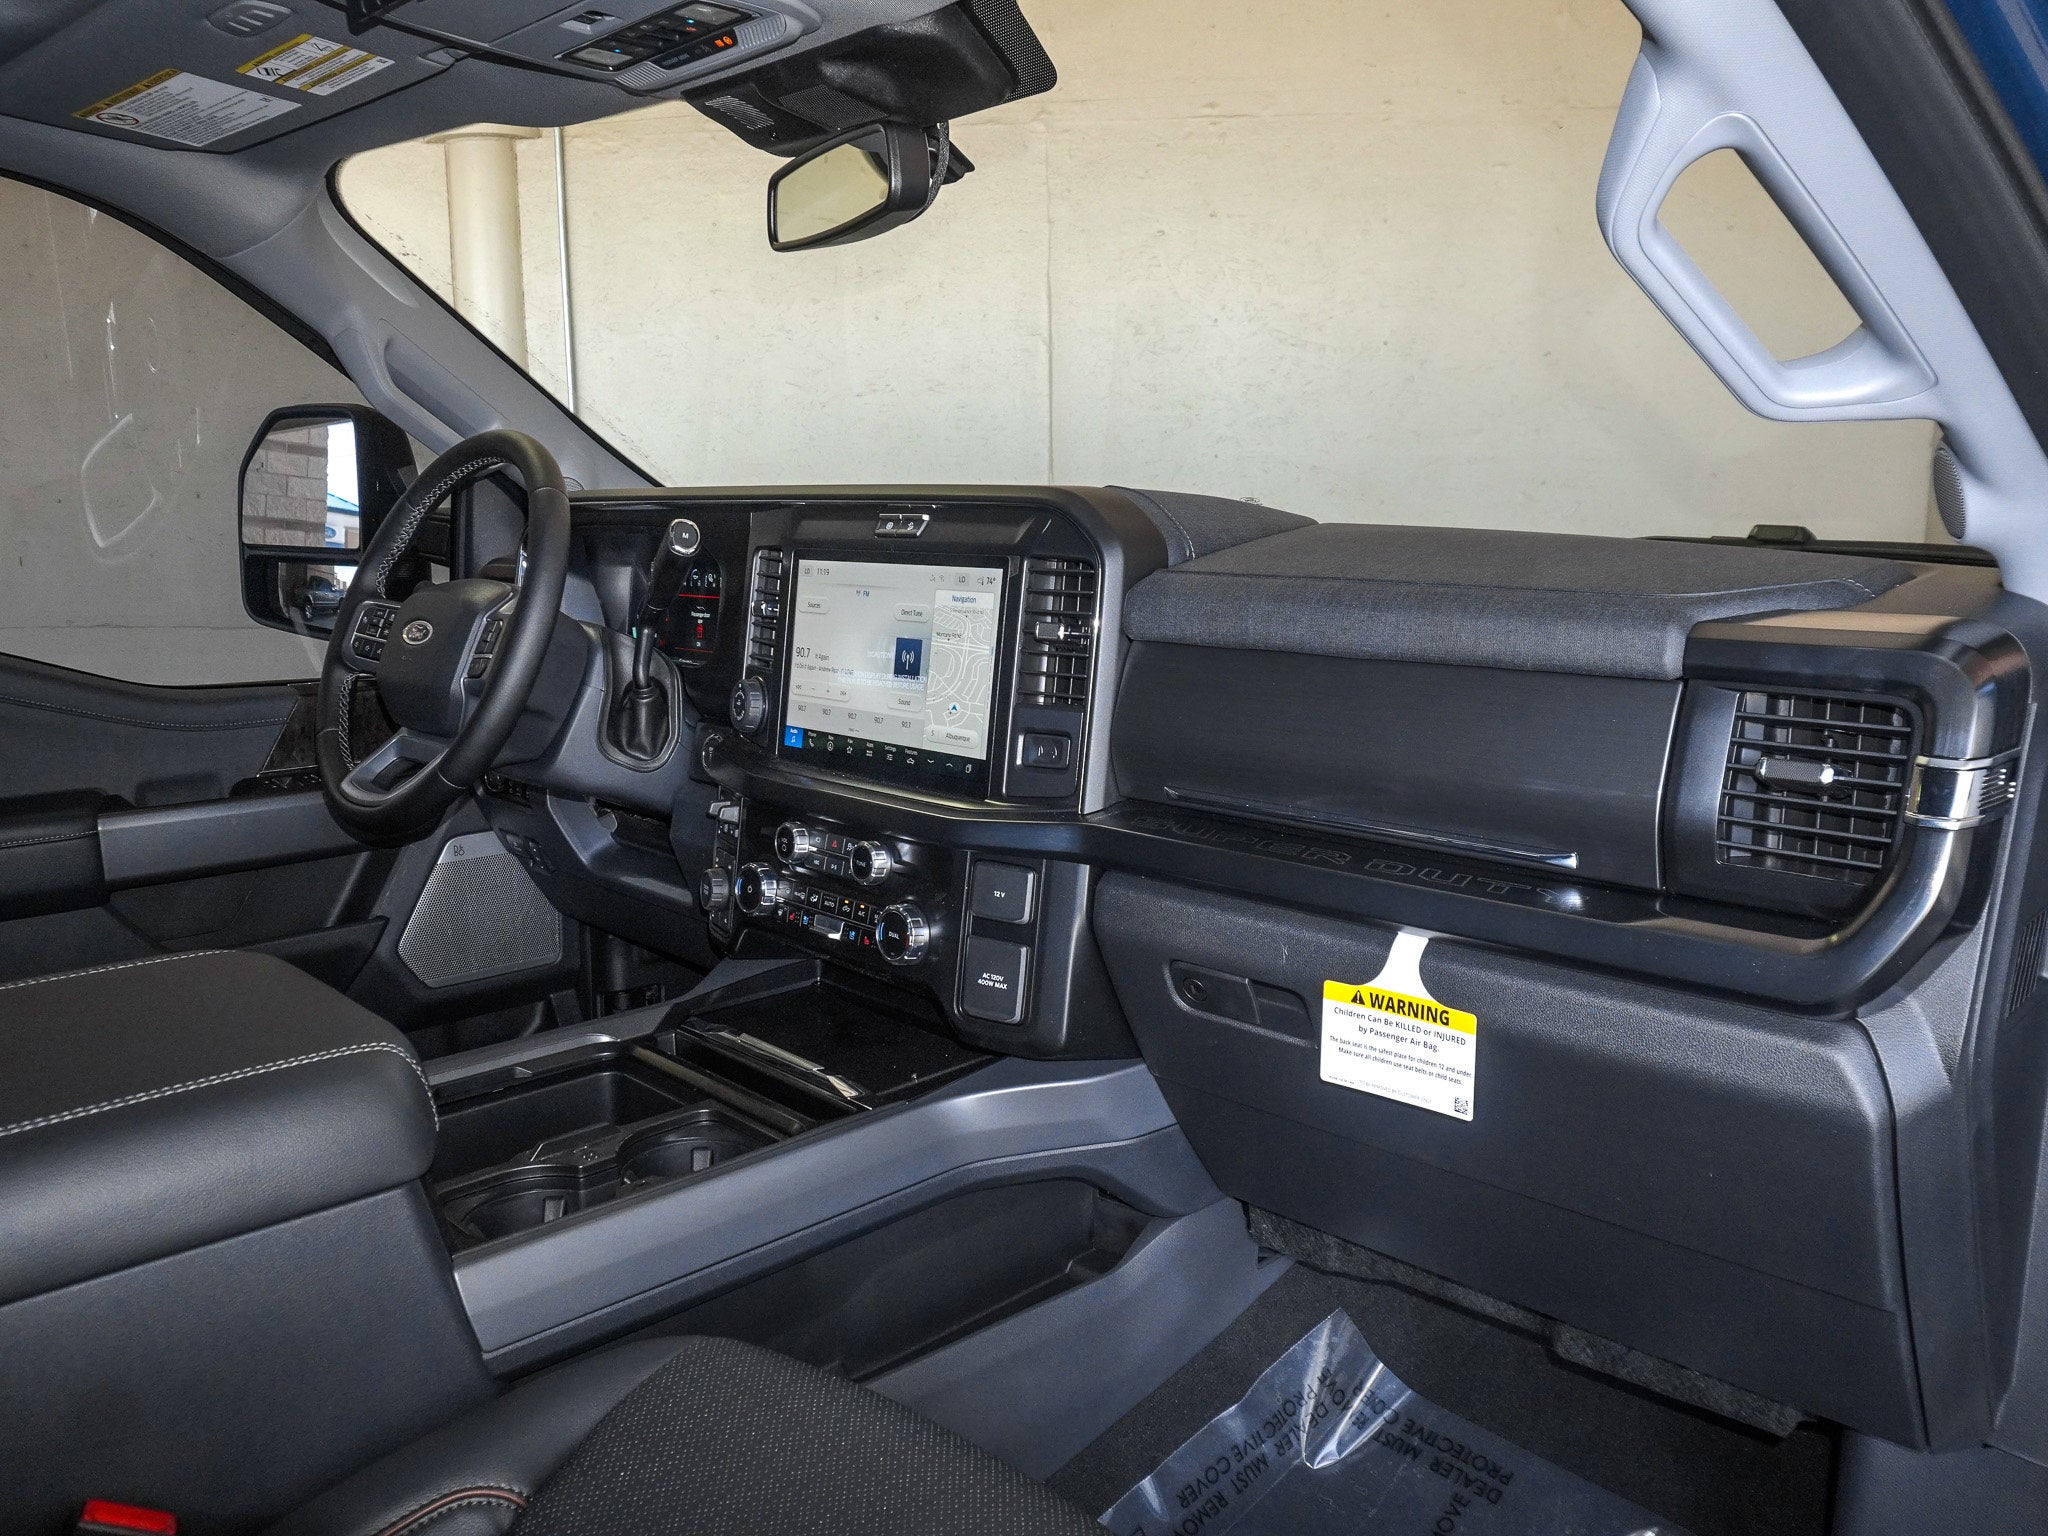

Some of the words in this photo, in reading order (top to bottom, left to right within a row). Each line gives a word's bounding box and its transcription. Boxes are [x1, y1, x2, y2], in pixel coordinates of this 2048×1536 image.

[951, 595, 977, 604] Navigation
[795, 647, 811, 658] 90.7
[897, 698, 911, 706] Sound
[945, 732, 971, 742] Albuquerque
[888, 931, 899, 940] DUAL
[977, 979, 994, 988] 400W
[994, 981, 1008, 990] MAX
[982, 972, 991, 980] AC
[991, 973, 1004, 982] 120V
[1333, 1006, 1366, 1020] Children
[1367, 1014, 1382, 1024] Can
[1384, 1018, 1393, 1026] Be
[1395, 1021, 1422, 1034] KILLED
[1433, 1031, 1466, 1046] INJURED
[1369, 992, 1450, 1026] WARNING
[1339, 1038, 1351, 1046] back
[1352, 1041, 1363, 1049] seat
[1378, 1048, 1393, 1056] safest
[1393, 1051, 1407, 1060] place
[1408, 1054, 1416, 1062] for
[1416, 1057, 1438, 1068] children
[1358, 1024, 1368, 1035] by
[1369, 1027, 1408, 1044] Passenger
[1410, 1037, 1421, 1047] Air
[1423, 1041, 1440, 1053] Bag.
[1338, 1046, 1352, 1055] Make
[1372, 1055, 1393, 1065] children
[1403, 1063, 1414, 1072] seat
[1415, 1066, 1427, 1075] belts
[1435, 1072, 1447, 1080] child
[1233, 1384, 1319, 1463] PROTECTIVE
[1274, 1402, 1329, 1458] DEALER
[1371, 1427, 1423, 1463] MUST
[1402, 1417, 1515, 1487] PROTECTIVE
[1175, 1456, 1231, 1509] COVER
[1230, 1452, 1270, 1496] MUST
[1429, 1455, 1504, 1506] DEALER
